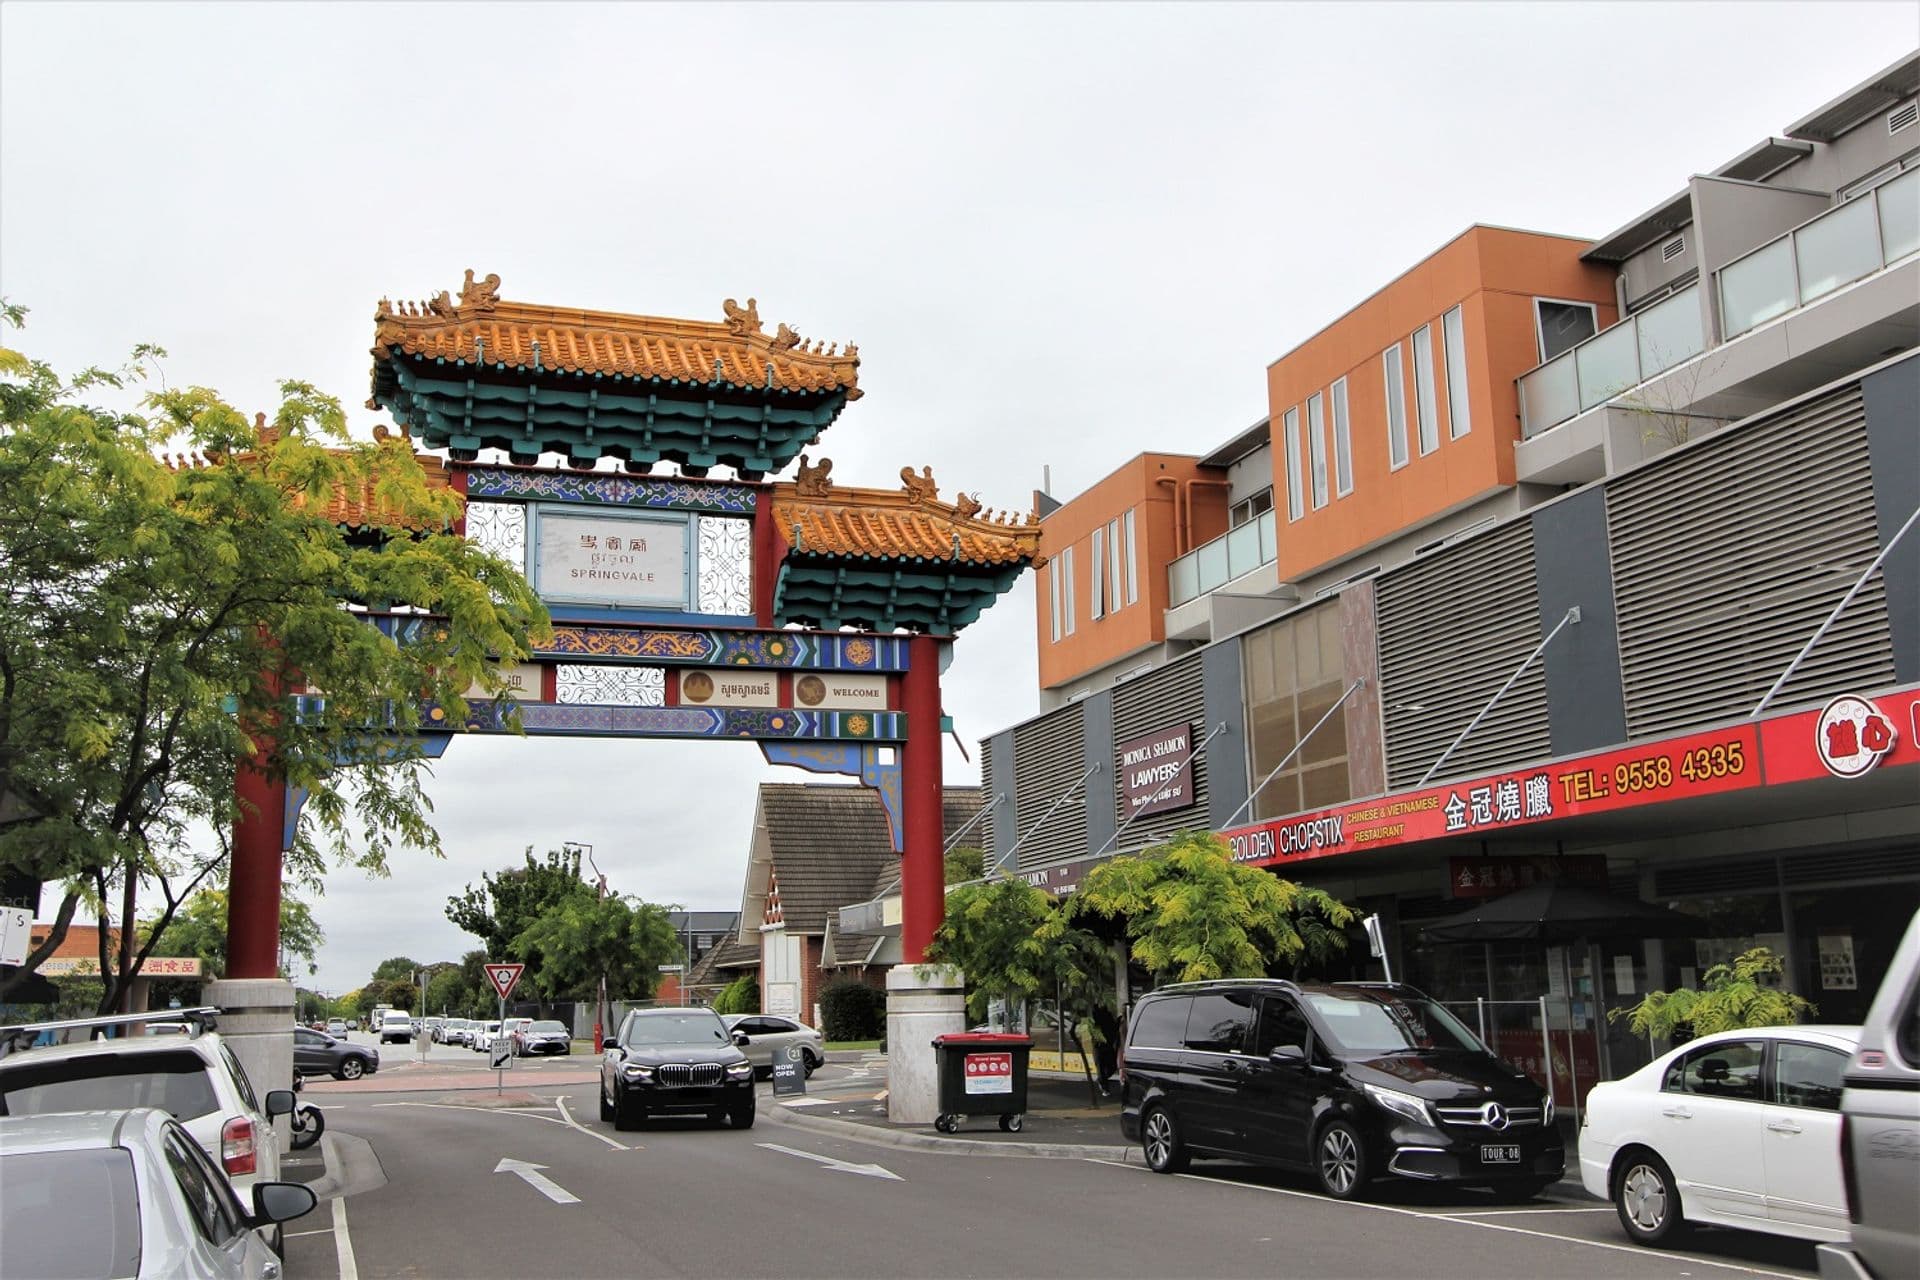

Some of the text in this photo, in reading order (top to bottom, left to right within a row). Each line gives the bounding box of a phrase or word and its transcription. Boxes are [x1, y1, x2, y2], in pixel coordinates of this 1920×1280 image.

[571, 568, 655, 582] SPRINGVALE
[833, 688, 879, 698] WELCOME
[1123, 735, 1186, 767] MONICA SHAMON
[1131, 761, 1180, 789] LAWYERS
[1559, 742, 1745, 803] TEL: 9558 4335
[1346, 796, 1439, 825] CHINESE & VIETNAMESE
[1444, 775, 1552, 831] 金冠燒臘
[1229, 815, 1345, 863] GOLDEN CHOPSTIX
[1354, 824, 1405, 842] RESTAURANT
